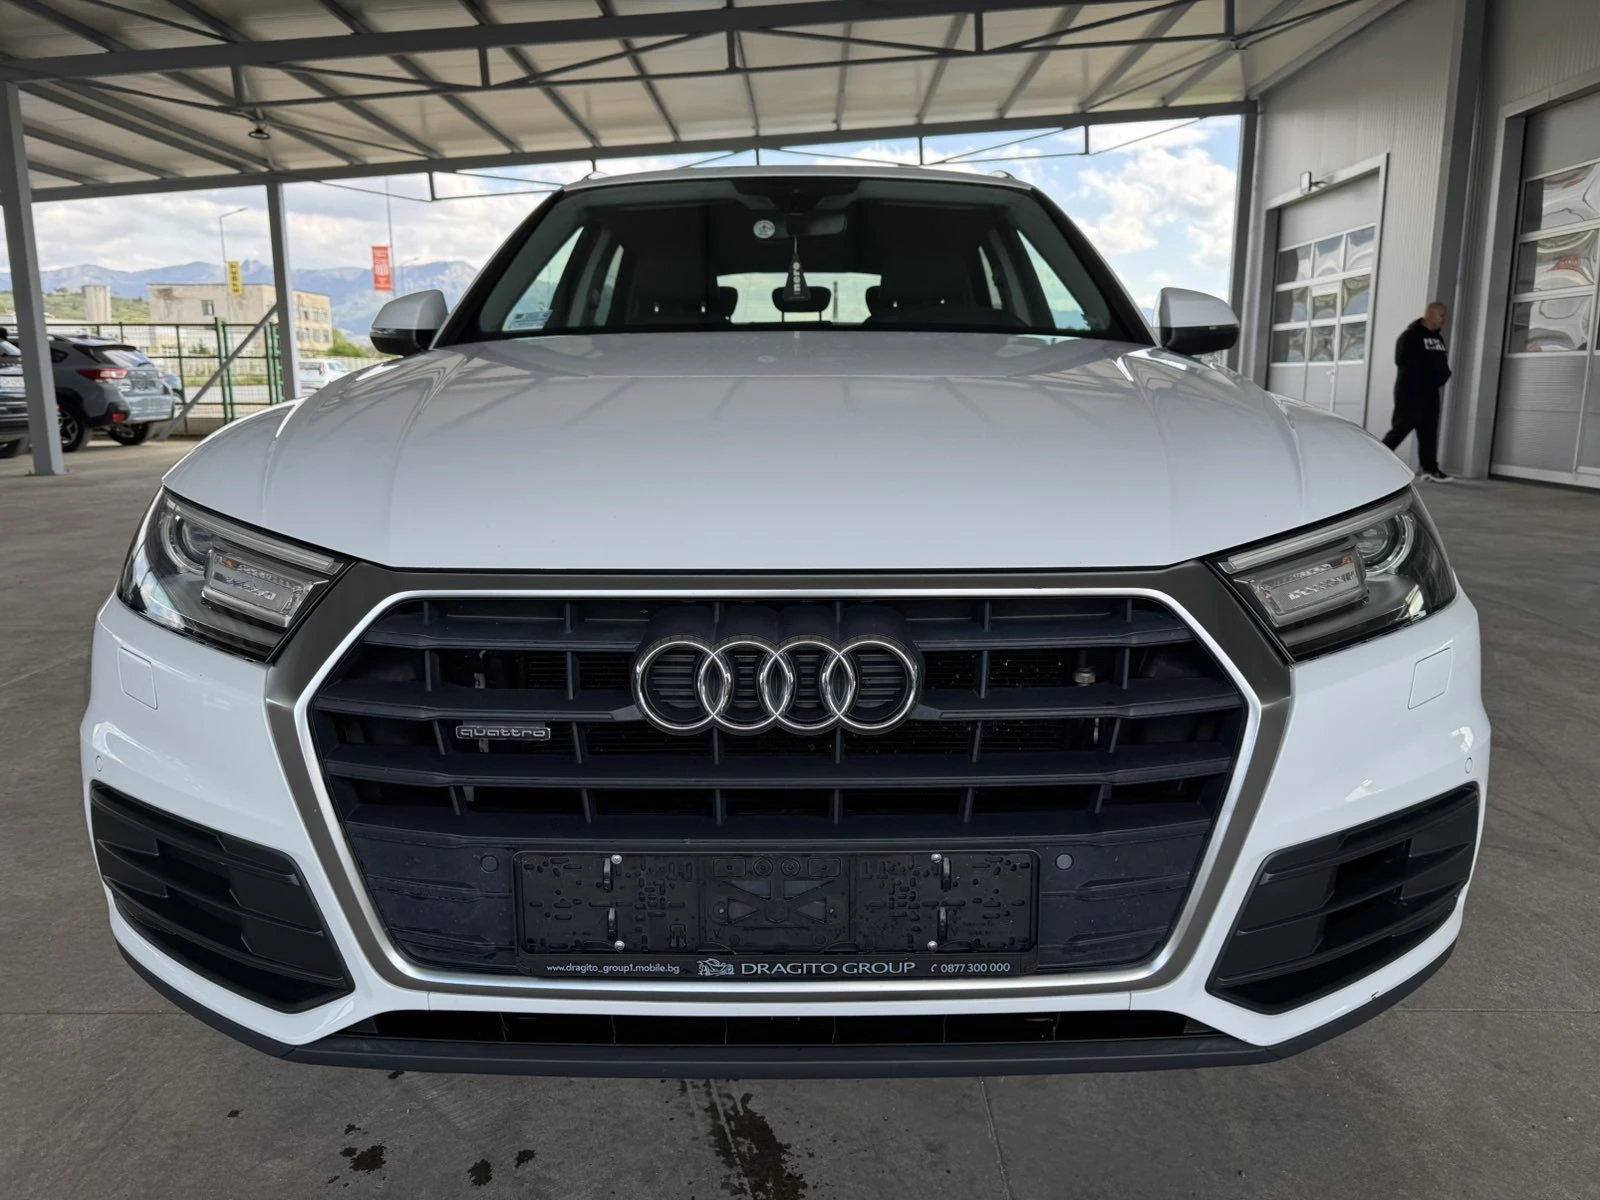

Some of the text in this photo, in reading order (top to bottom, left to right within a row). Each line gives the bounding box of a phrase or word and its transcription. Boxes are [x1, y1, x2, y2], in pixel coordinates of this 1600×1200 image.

[459, 728, 546, 738] quattro
[546, 962, 680, 974] www.dragito_group1.mobile.bg
[741, 961, 916, 975] DRAGITO GROUP
[940, 962, 1011, 973] 0877 300 000
